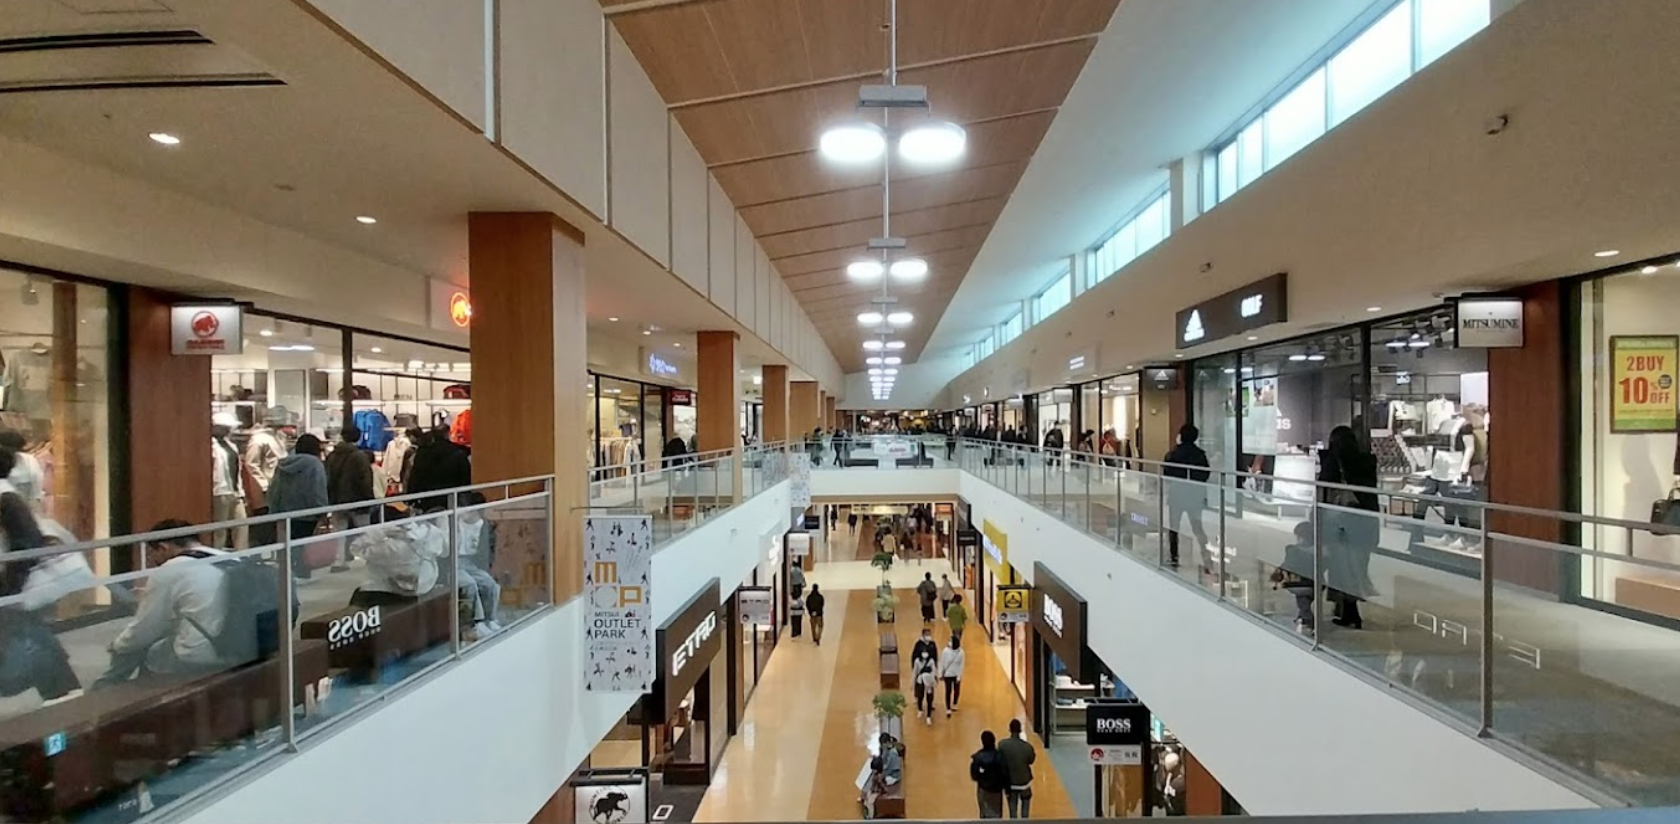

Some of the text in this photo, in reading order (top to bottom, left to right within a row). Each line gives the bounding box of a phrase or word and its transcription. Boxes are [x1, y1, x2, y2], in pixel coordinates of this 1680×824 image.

[1463, 318, 1520, 329] MITSUMINE
[1626, 355, 1665, 371] 2BUY
[1618, 376, 1649, 404] 10
[1650, 391, 1670, 405] OFF
[594, 618, 642, 629] OUTLET
[594, 629, 626, 639] PARK
[1096, 717, 1132, 730] BOSS
